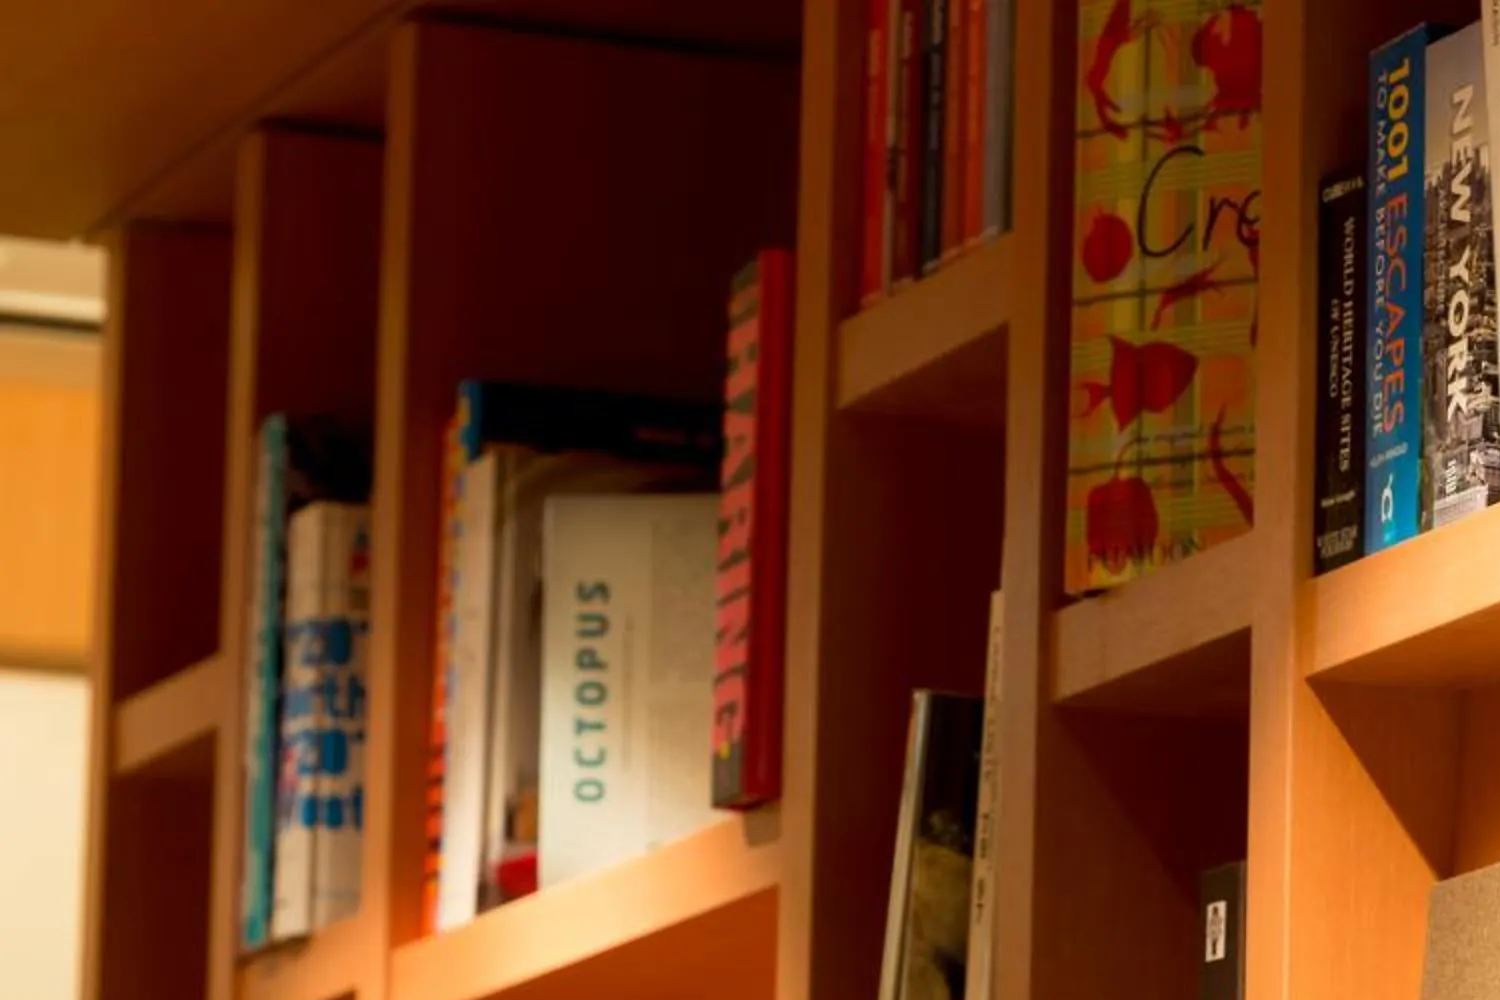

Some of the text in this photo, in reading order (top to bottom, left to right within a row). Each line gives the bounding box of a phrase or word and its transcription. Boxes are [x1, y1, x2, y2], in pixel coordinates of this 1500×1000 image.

[1387, 57, 1411, 181] 1001
[1328, 327, 1340, 398] UNESCO
[1338, 217, 1355, 472] WORLD HERITAGE SITES
[1372, 71, 1387, 439] TO MAKE BEFORE YOU DIE
[1383, 192, 1408, 434] ESCAPES
[1447, 84, 1475, 423] NEW YORK
[573, 581, 611, 804] OCTOPUS
